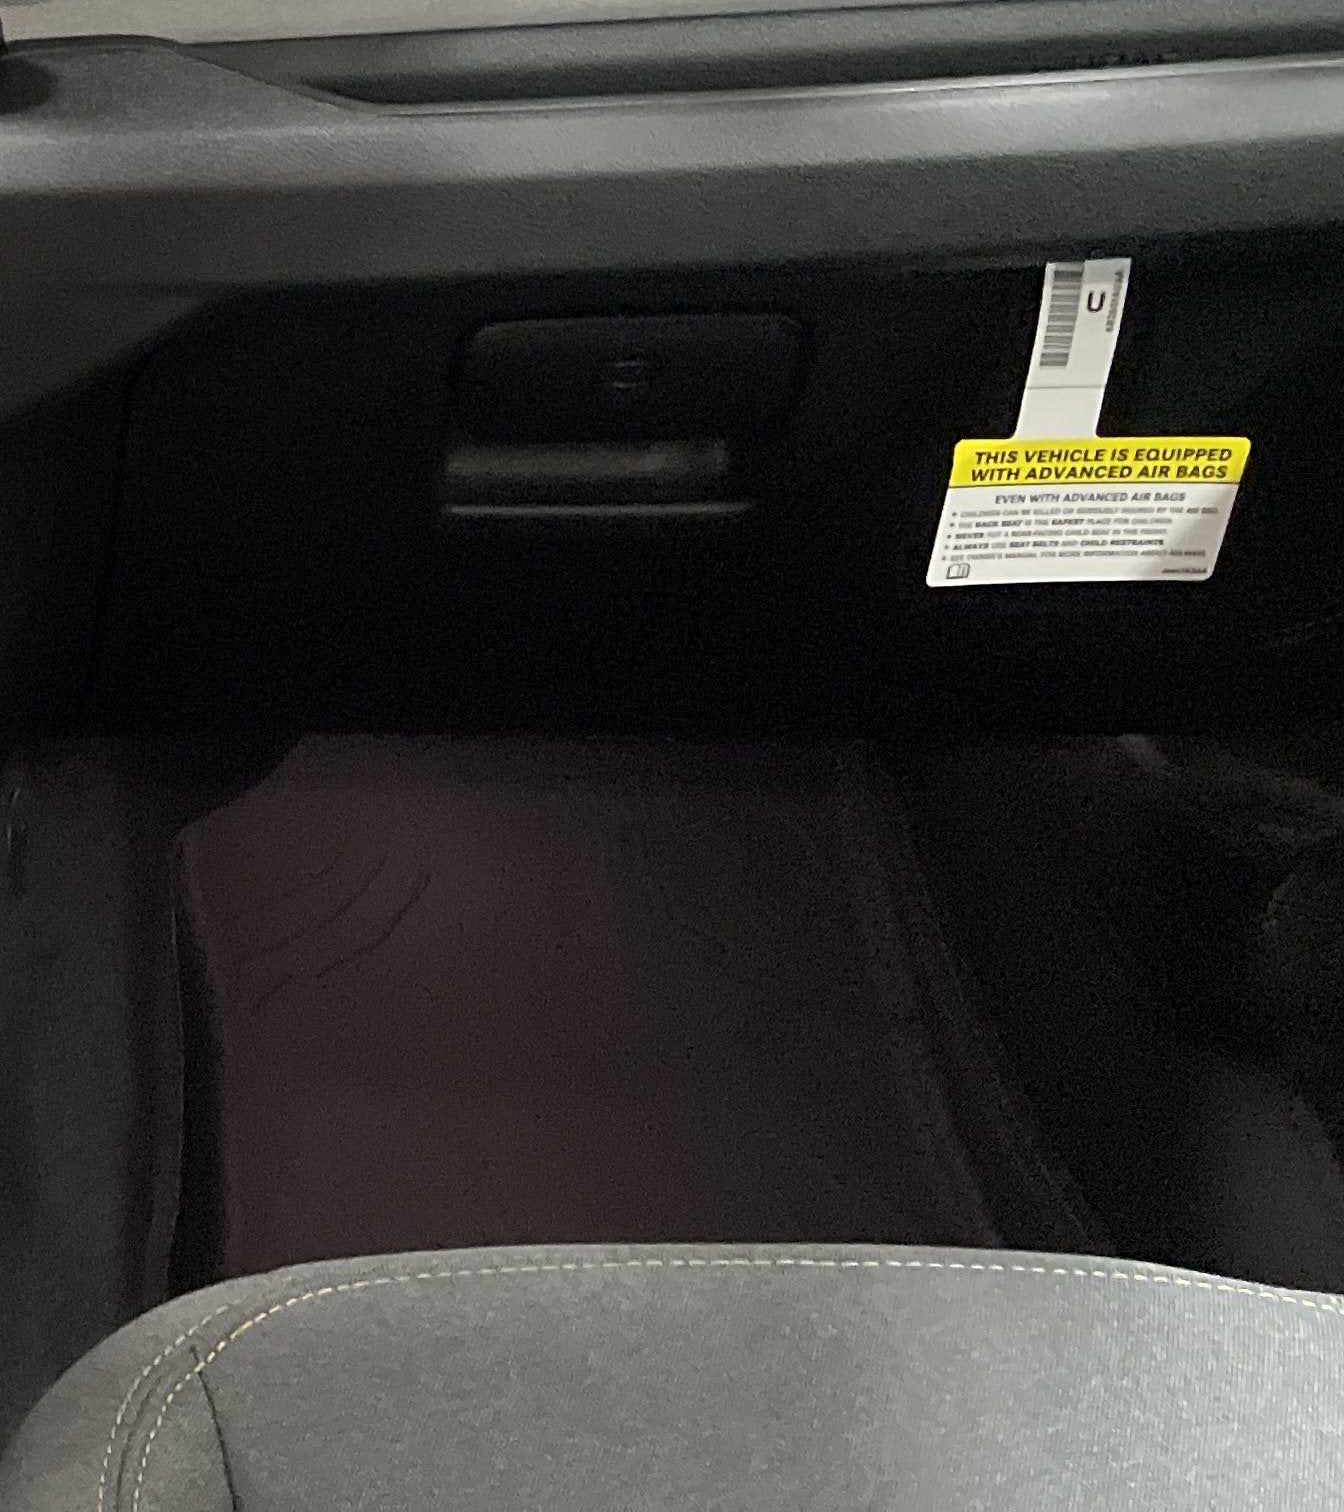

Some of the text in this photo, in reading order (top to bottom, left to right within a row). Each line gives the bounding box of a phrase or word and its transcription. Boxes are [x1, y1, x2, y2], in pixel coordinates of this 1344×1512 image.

[1087, 290, 1106, 313] U
[975, 447, 1233, 465] THIS VEHICLE IS EQUIPPED
[970, 464, 1228, 482] WITH ADVANCED AIR BAGS
[995, 491, 1187, 505] EVEN WITH ADVANCED AIR BAGS
